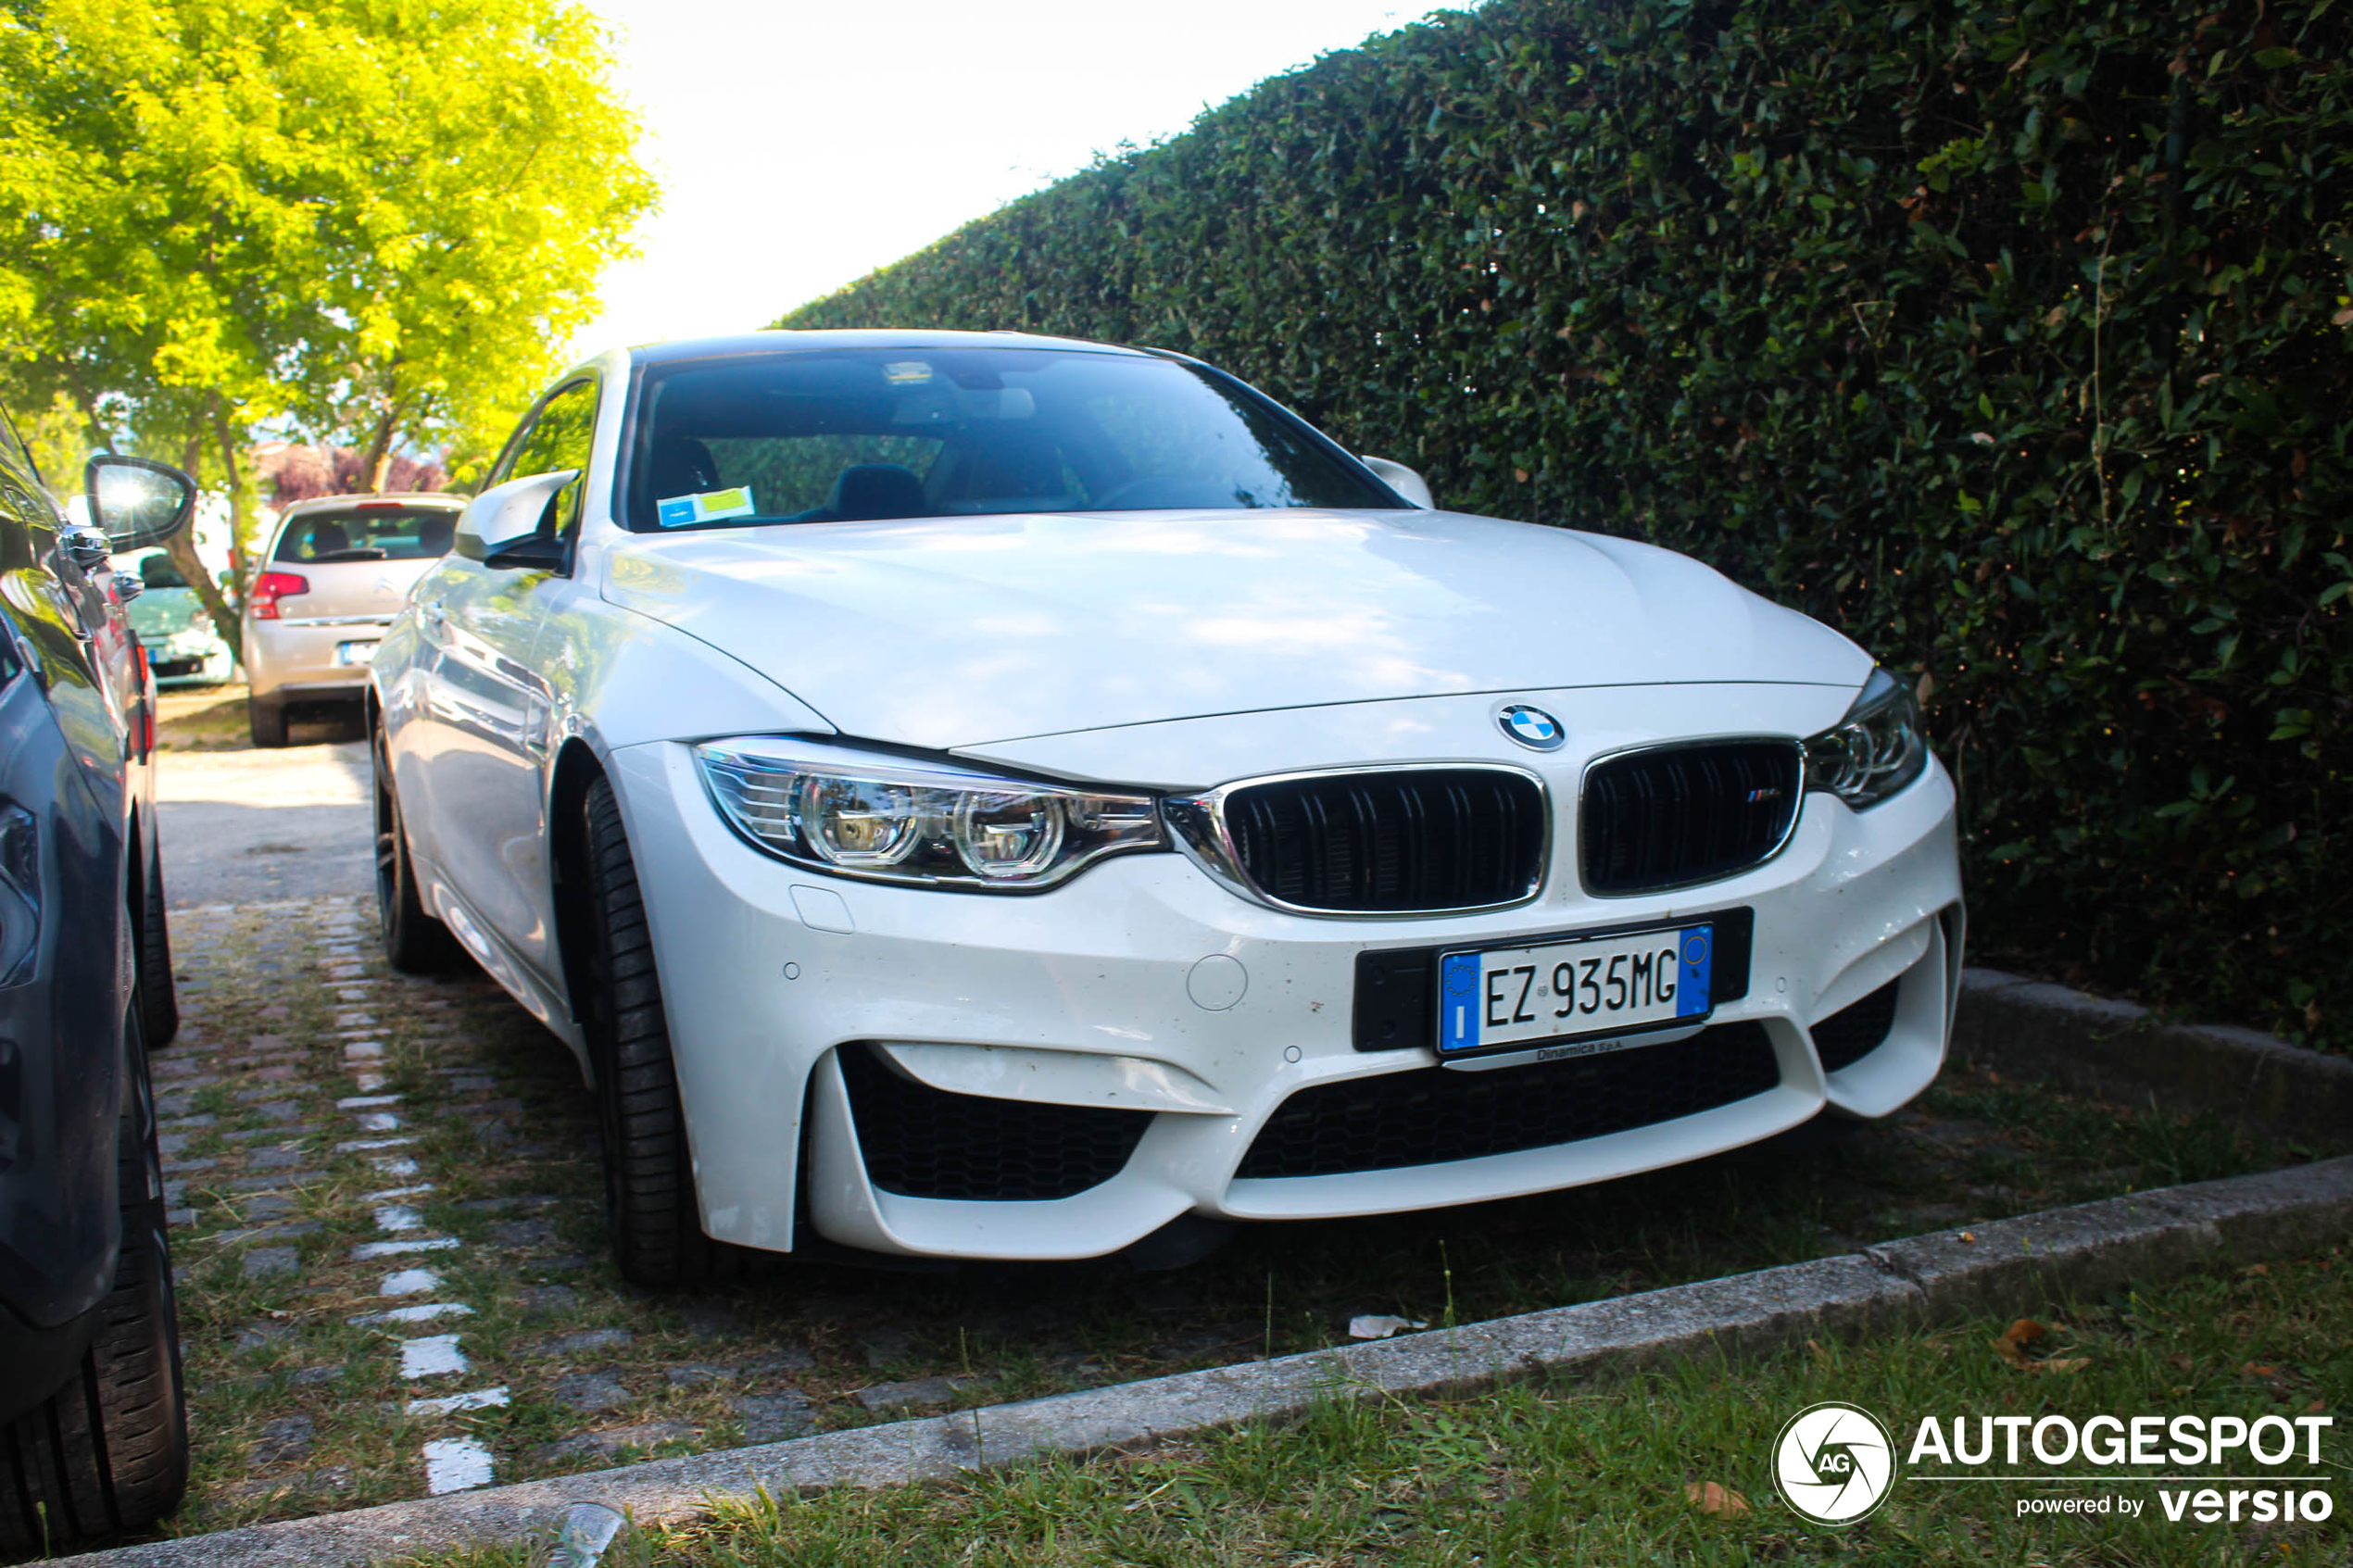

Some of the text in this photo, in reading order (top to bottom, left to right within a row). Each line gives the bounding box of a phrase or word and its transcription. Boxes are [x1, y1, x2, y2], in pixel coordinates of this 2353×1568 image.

[1486, 948, 1677, 1027] EZ 935MG
[1455, 1006, 1466, 1039] I
[1537, 1042, 1595, 1061] Dinamica
